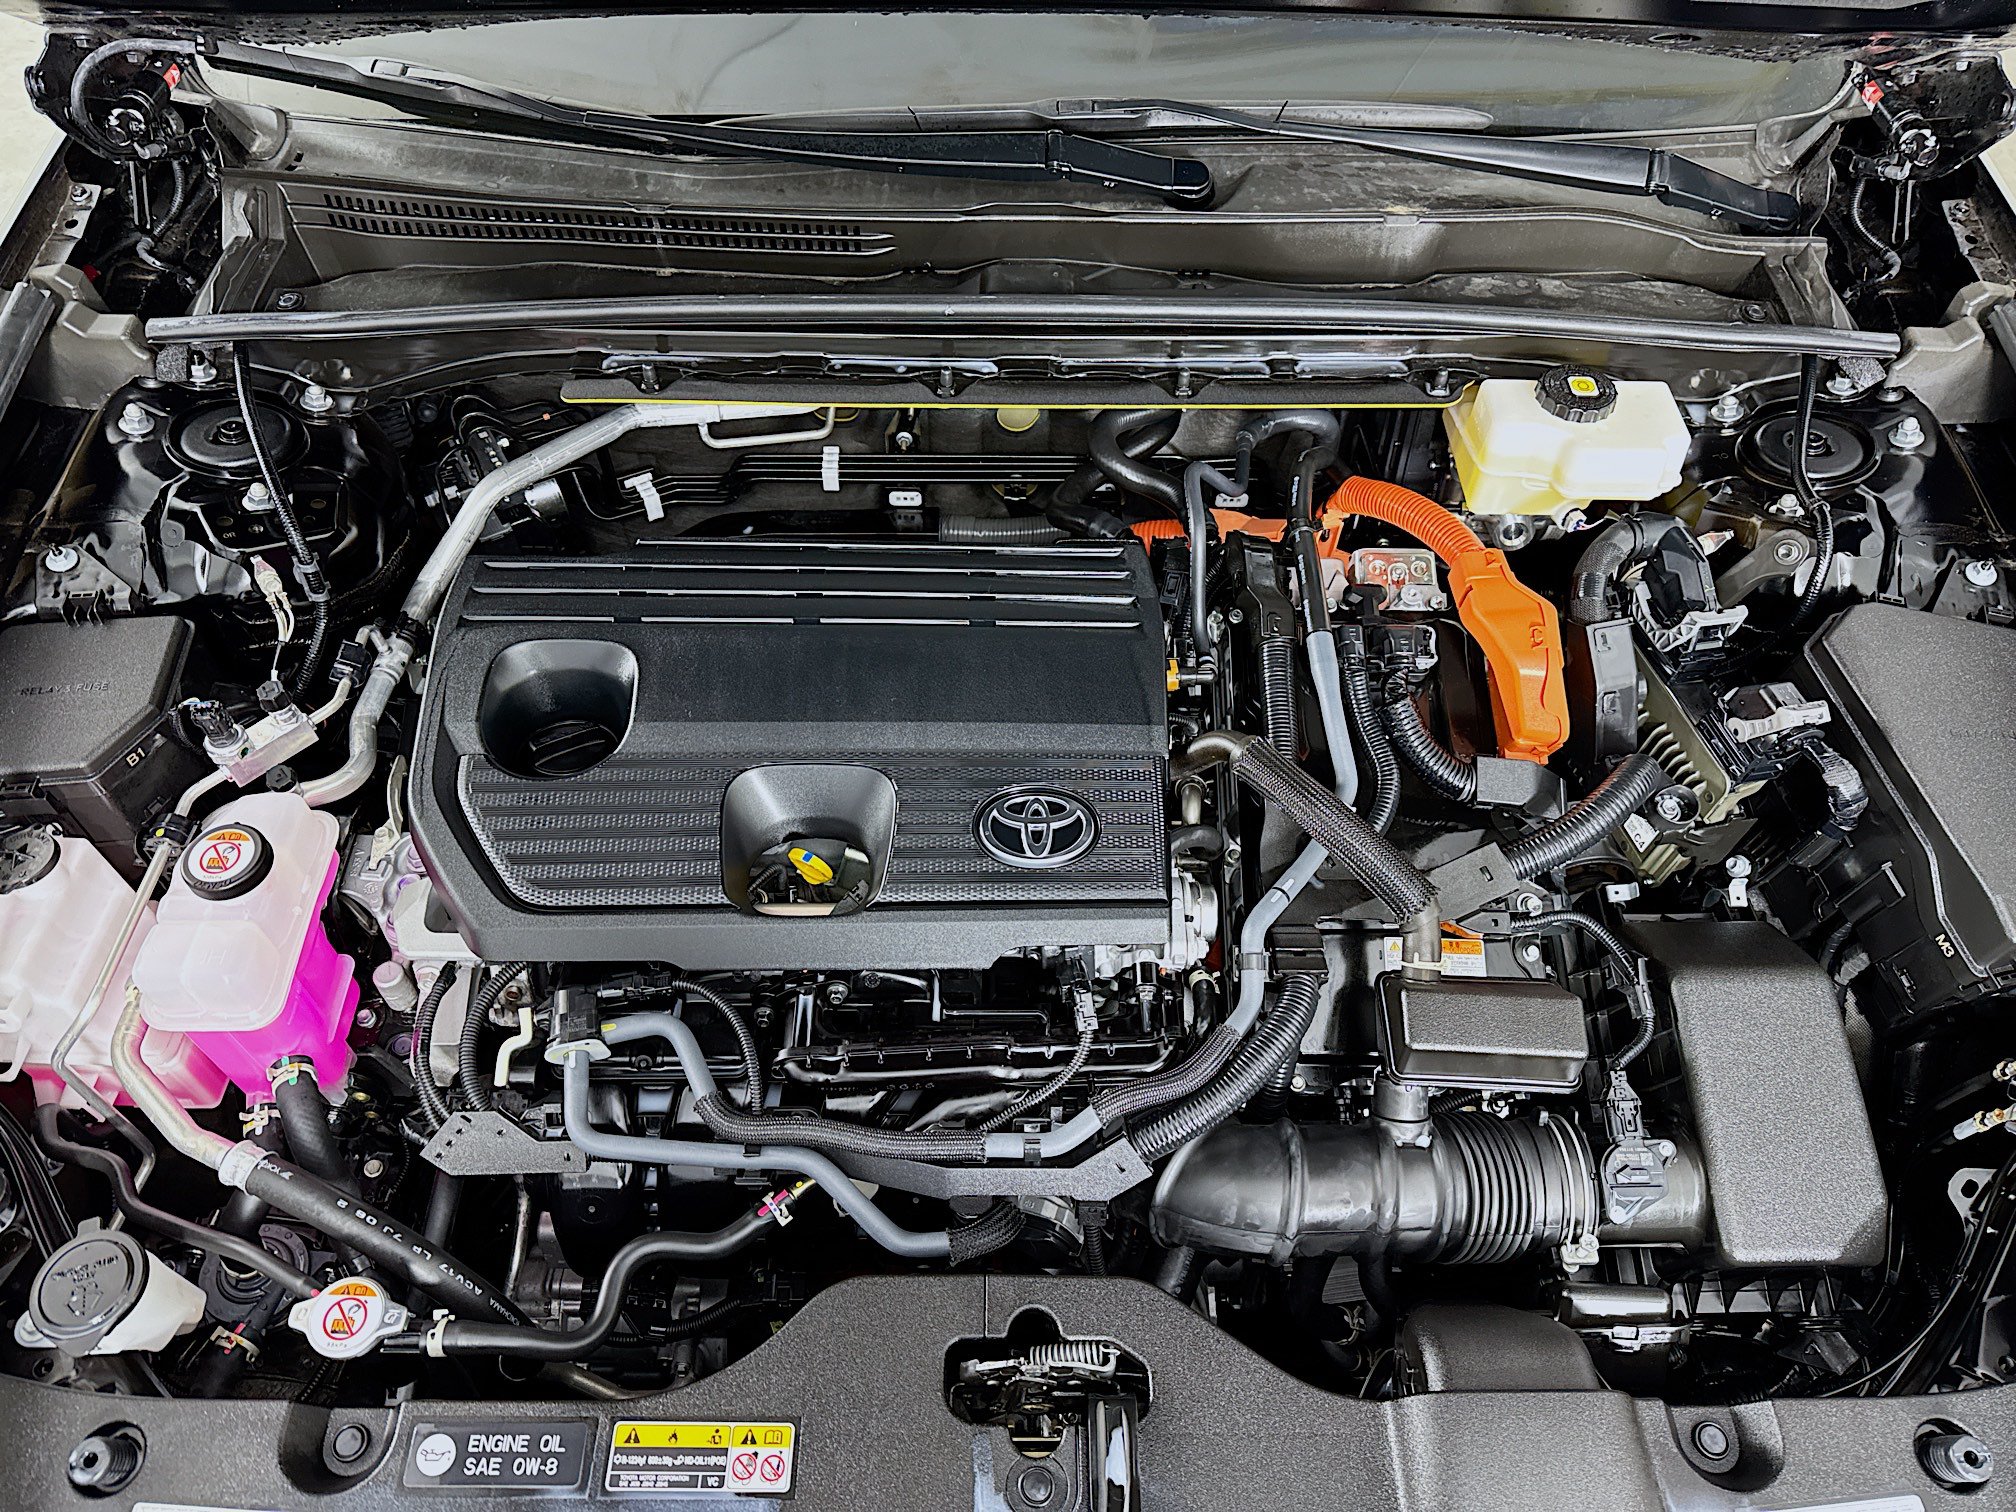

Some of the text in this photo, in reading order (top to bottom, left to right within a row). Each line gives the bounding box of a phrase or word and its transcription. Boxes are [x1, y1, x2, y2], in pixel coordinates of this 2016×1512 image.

[75, 681, 110, 692] FUSE
[126, 747, 146, 767] B1
[1935, 933, 1955, 957] M3
[337, 1199, 349, 1209] 2
[383, 1226, 403, 1242] 7J
[412, 1244, 432, 1261] LP
[439, 1263, 484, 1296] ACV17
[467, 1434, 566, 1453] ENGINE OIL
[463, 1457, 559, 1476] SAE 0W-8
[706, 1476, 720, 1487] VC
